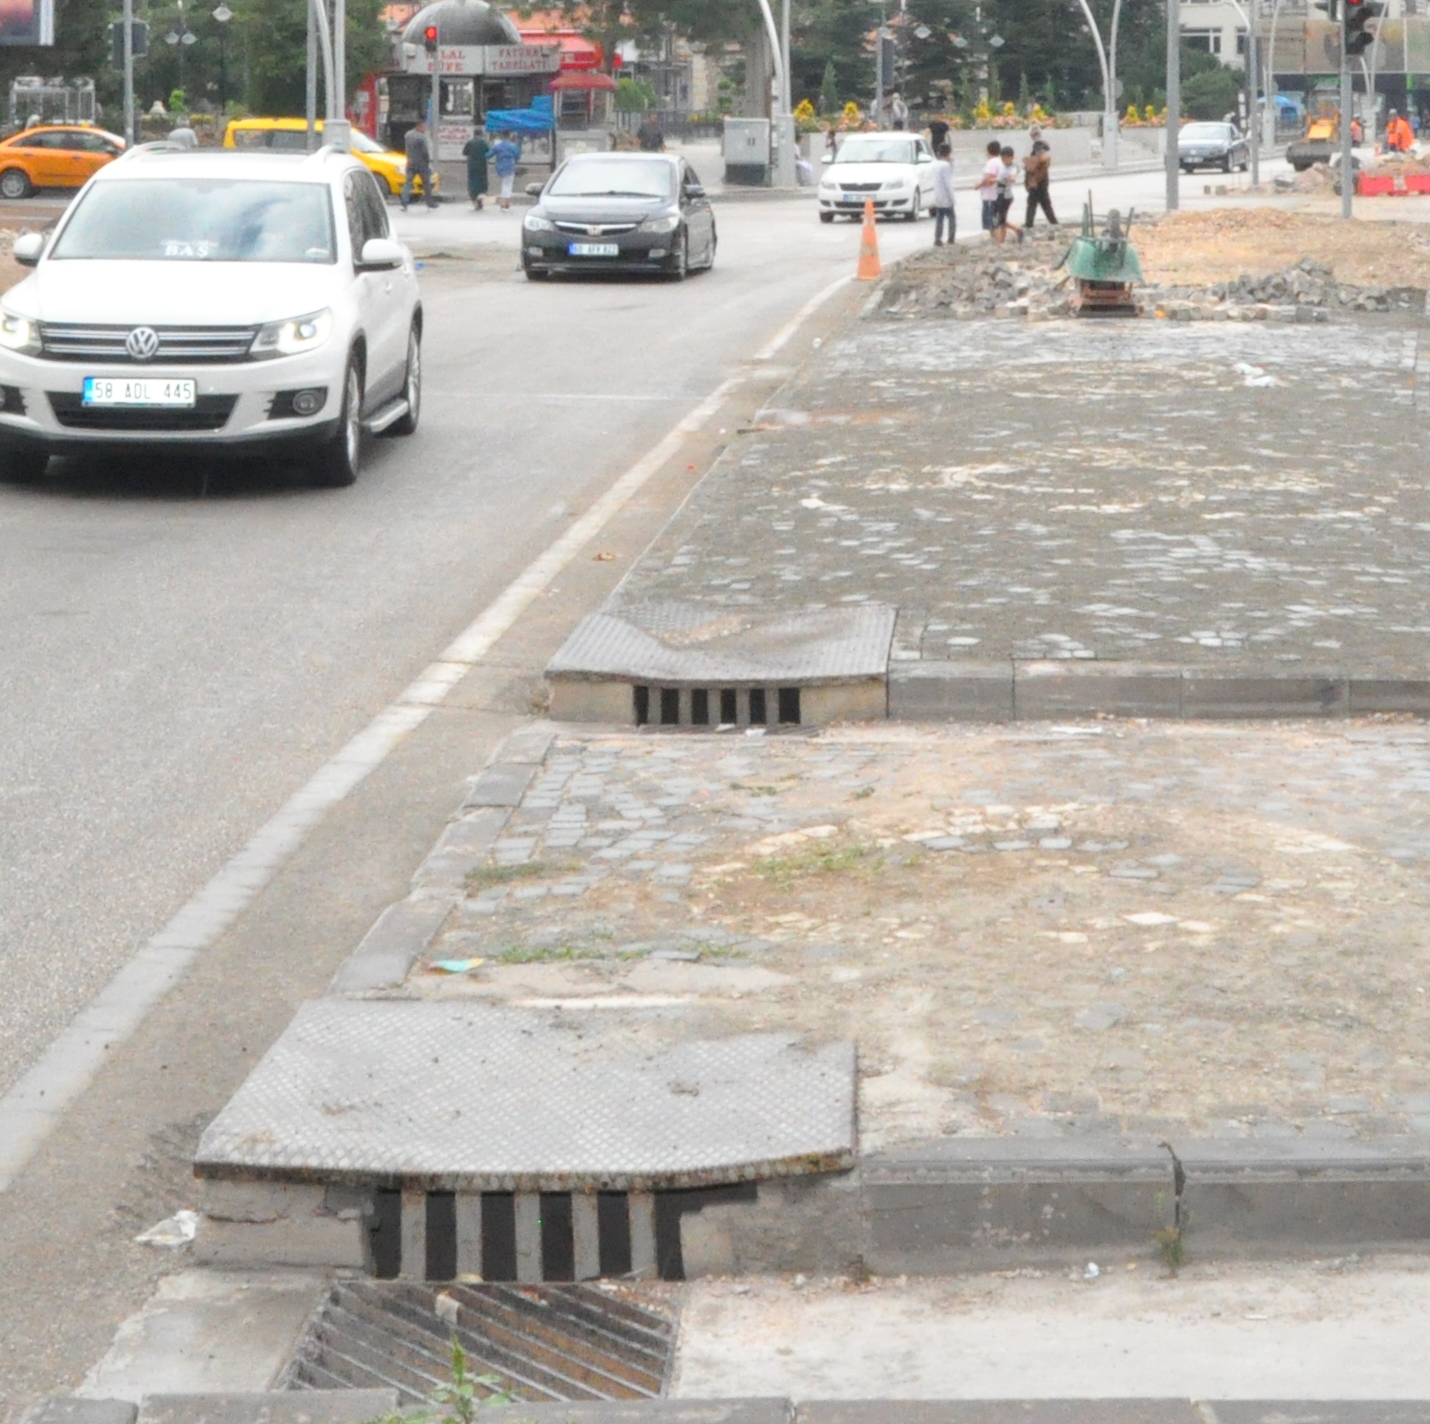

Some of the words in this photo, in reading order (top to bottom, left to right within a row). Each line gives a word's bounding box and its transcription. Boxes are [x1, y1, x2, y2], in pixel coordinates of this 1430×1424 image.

[95, 382, 113, 399] 58
[125, 382, 151, 399] ADL
[163, 382, 192, 400] 445
